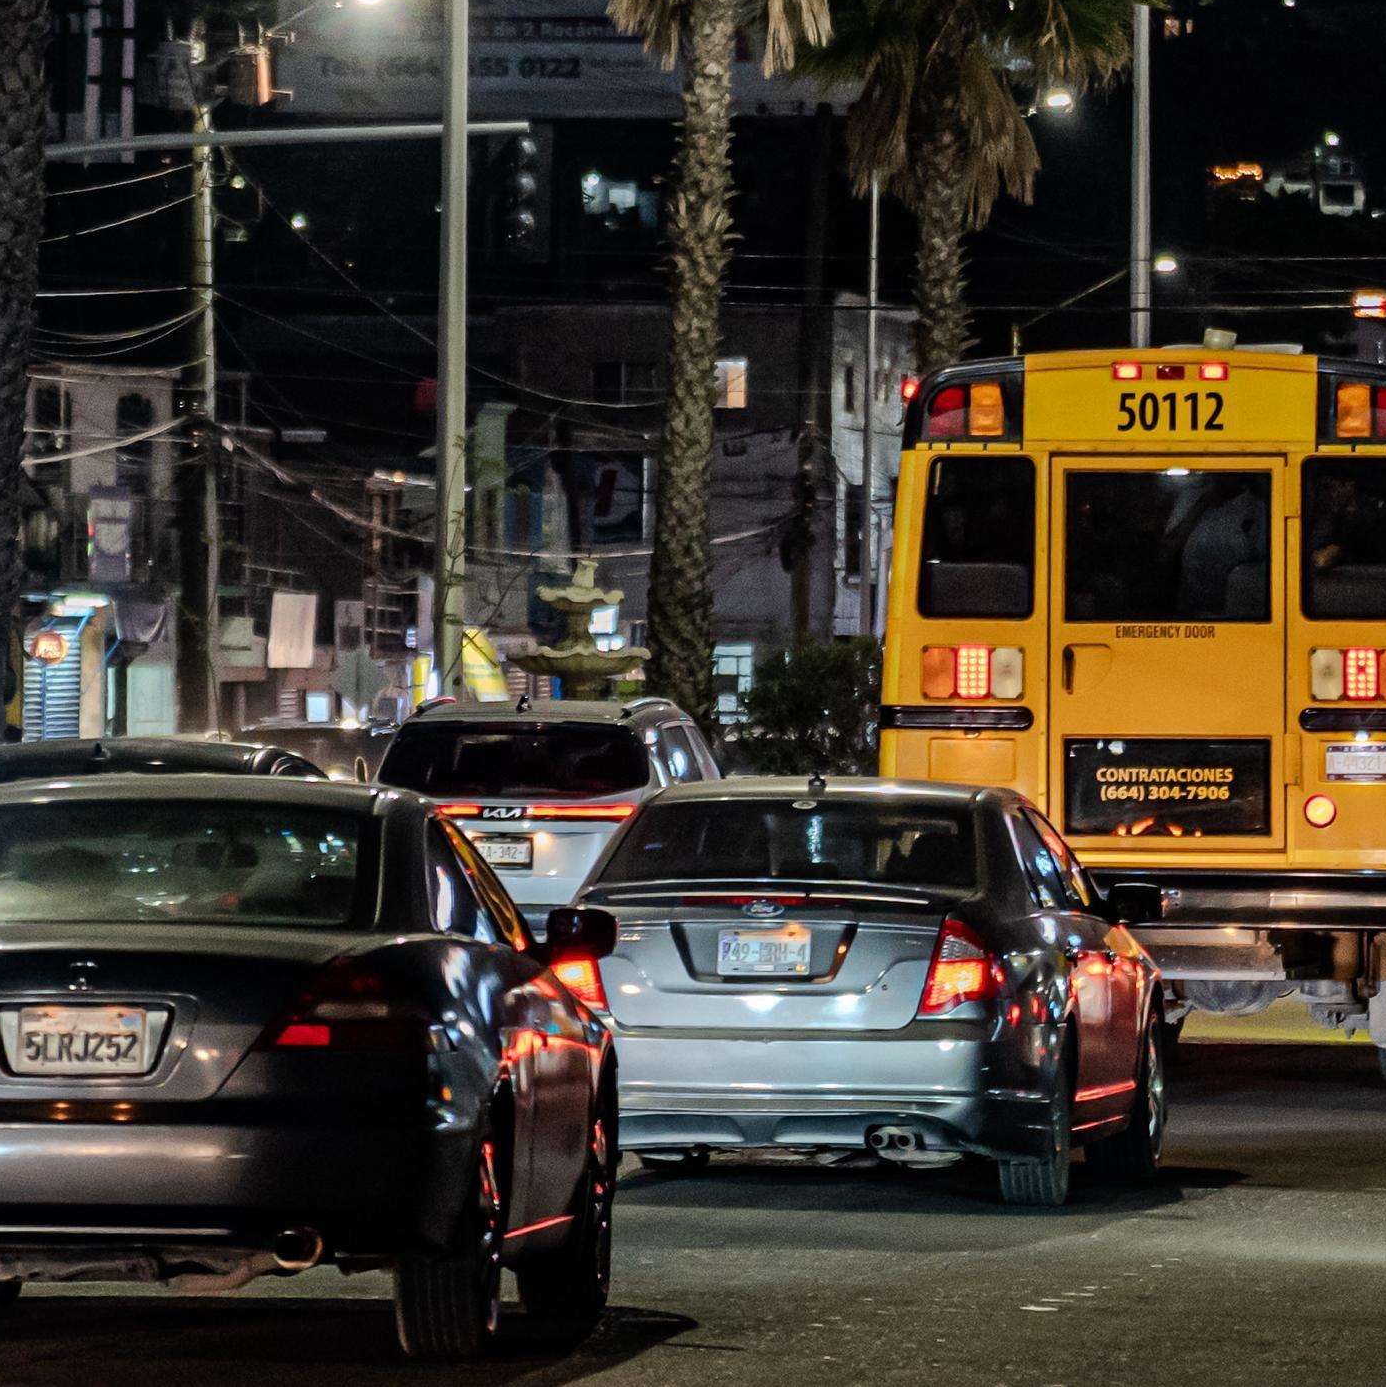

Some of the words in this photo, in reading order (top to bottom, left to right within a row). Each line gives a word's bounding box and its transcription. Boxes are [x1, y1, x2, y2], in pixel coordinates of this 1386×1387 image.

[1117, 391, 1224, 432] 50112
[1115, 625, 1181, 639] EMERGENCY
[1184, 625, 1216, 639] DOOR
[1095, 767, 1235, 783] CONTRATACIONES
[1100, 784, 1145, 802] (664)
[1148, 785, 1230, 801] 304-7906
[25, 1030, 138, 1062] 5LRJ252
